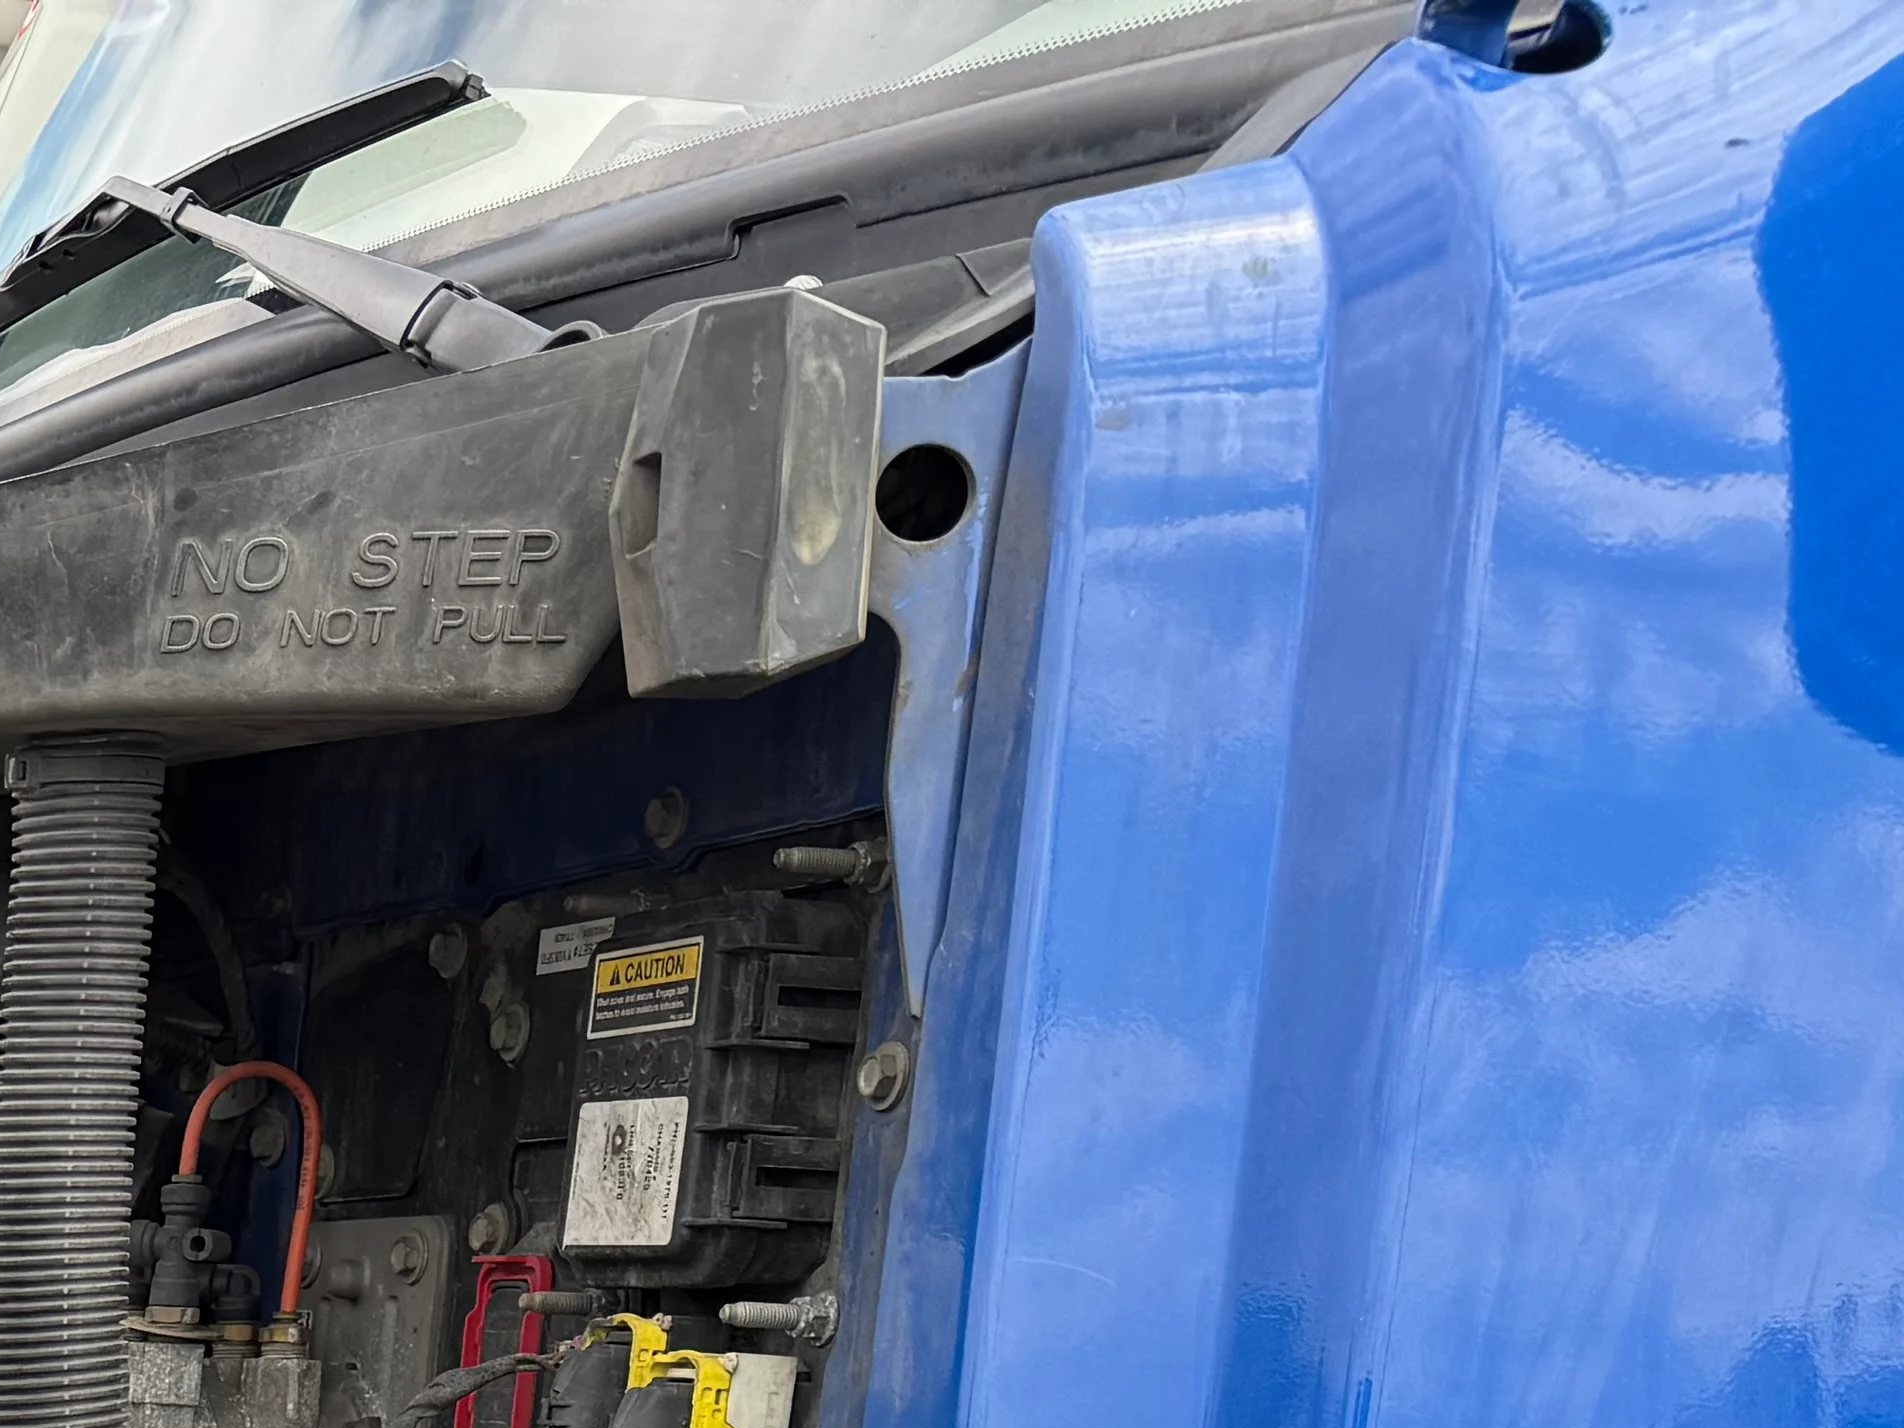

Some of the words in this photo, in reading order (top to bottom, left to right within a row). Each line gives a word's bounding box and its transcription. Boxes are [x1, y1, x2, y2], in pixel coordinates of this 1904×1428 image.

[171, 535, 292, 599] NO
[351, 529, 564, 590] STEP
[159, 611, 242, 654] DO
[279, 606, 396, 650] NOT
[432, 604, 569, 645] PULL
[624, 954, 686, 984] CAUTION
